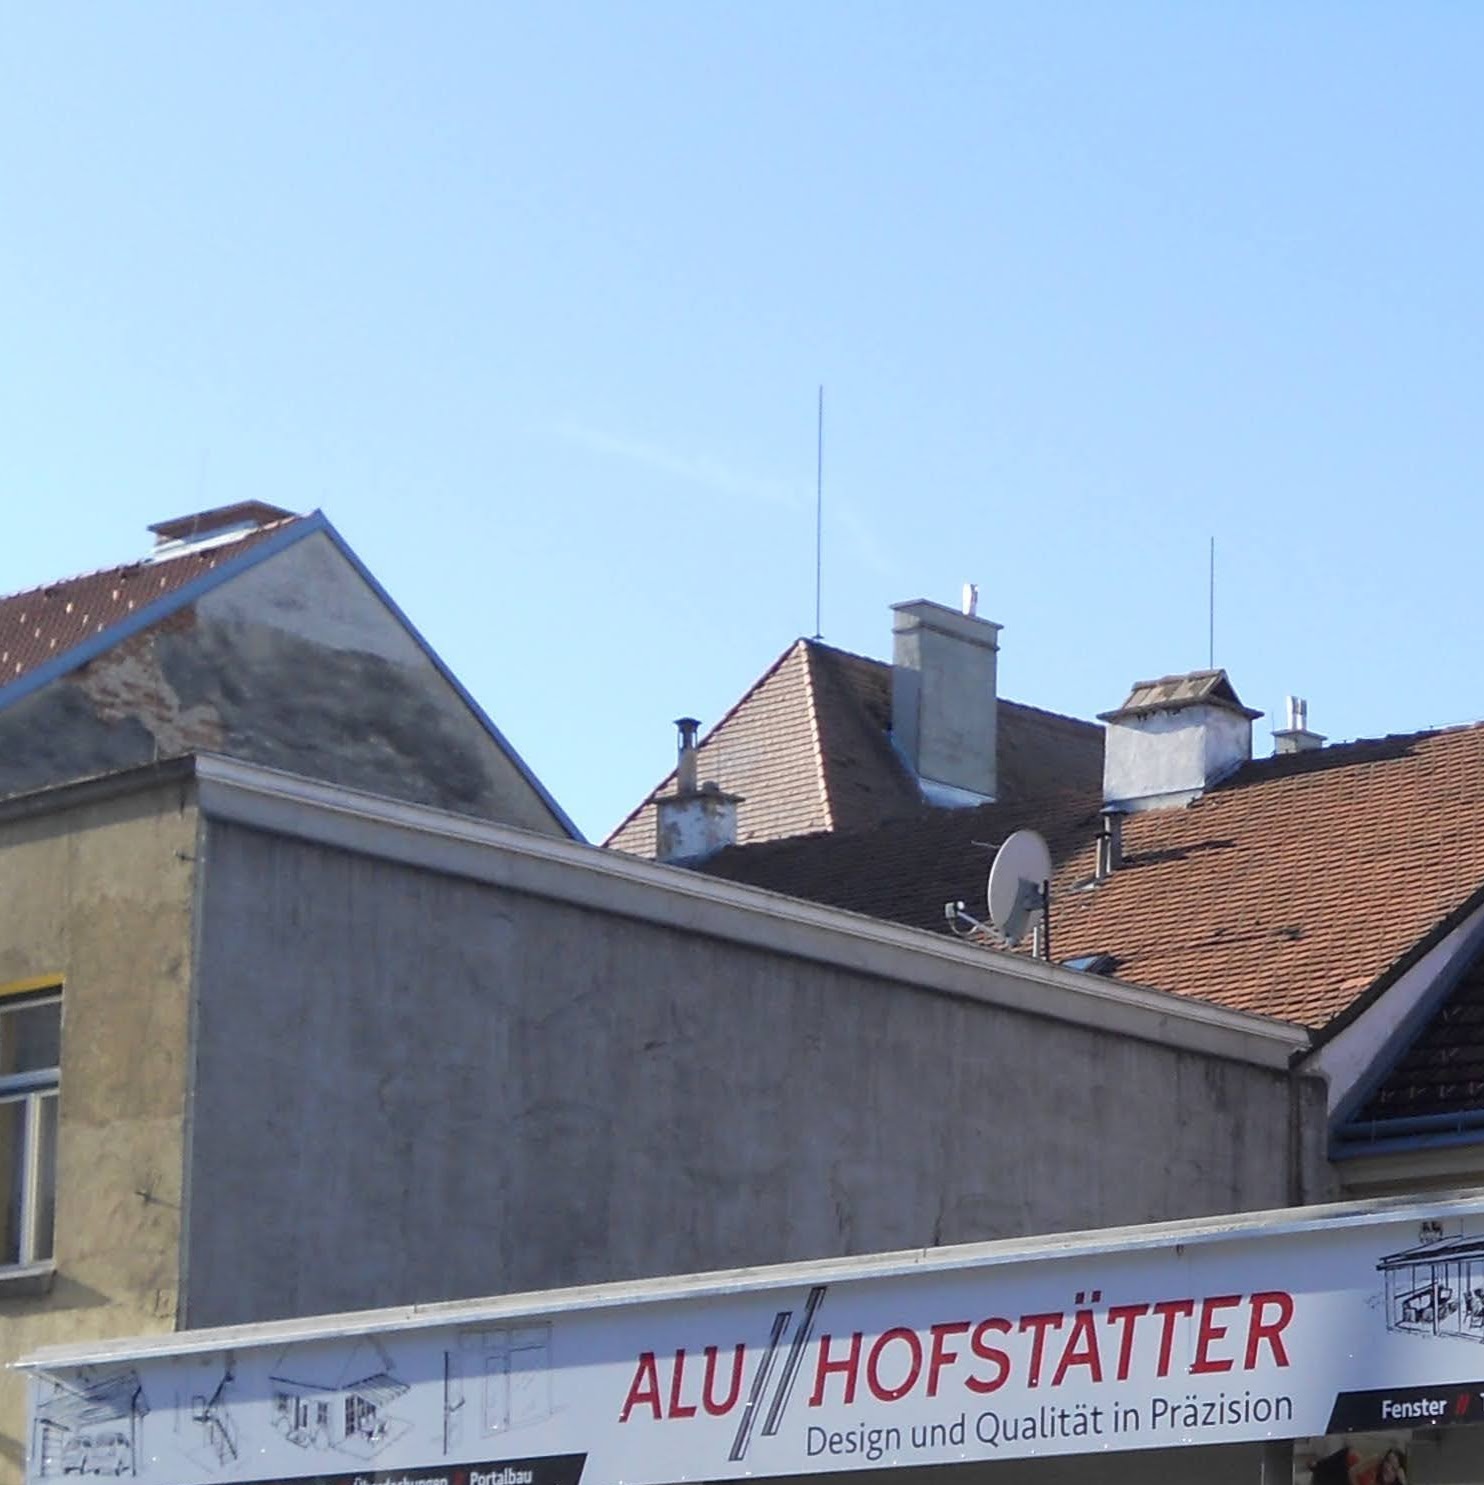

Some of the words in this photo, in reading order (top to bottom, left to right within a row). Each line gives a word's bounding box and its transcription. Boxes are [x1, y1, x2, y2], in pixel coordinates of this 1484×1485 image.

[619, 1342, 745, 1424] ALU
[809, 1291, 1294, 1407] HOFSTÄTTER
[807, 1427, 900, 1461] Design
[910, 1413, 964, 1448] und
[975, 1405, 1103, 1445] Qualität
[1114, 1401, 1139, 1431] in
[1152, 1392, 1293, 1430] Präzision
[1382, 1396, 1446, 1421] Fenster
